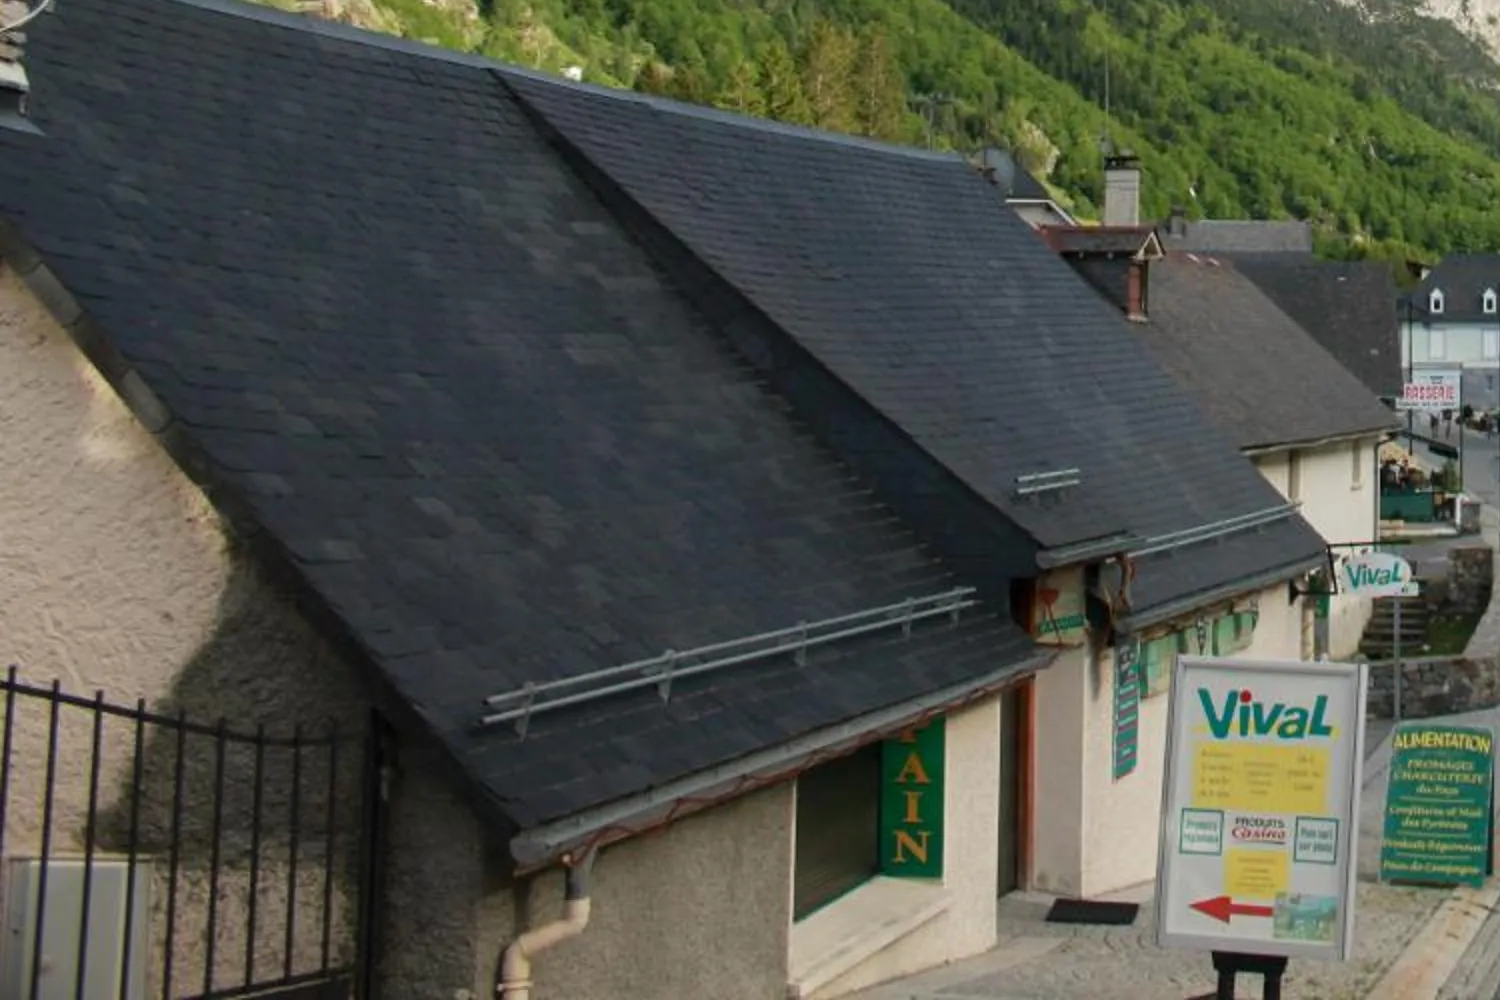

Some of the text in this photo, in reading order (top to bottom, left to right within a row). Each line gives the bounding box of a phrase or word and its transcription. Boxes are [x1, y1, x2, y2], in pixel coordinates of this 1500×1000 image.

[1401, 385, 1455, 401] RASSERIE
[1393, 731, 1490, 755] ALIMENTATION
[1235, 816, 1285, 828] PRODUITS
[1231, 827, 1287, 840] Casino
